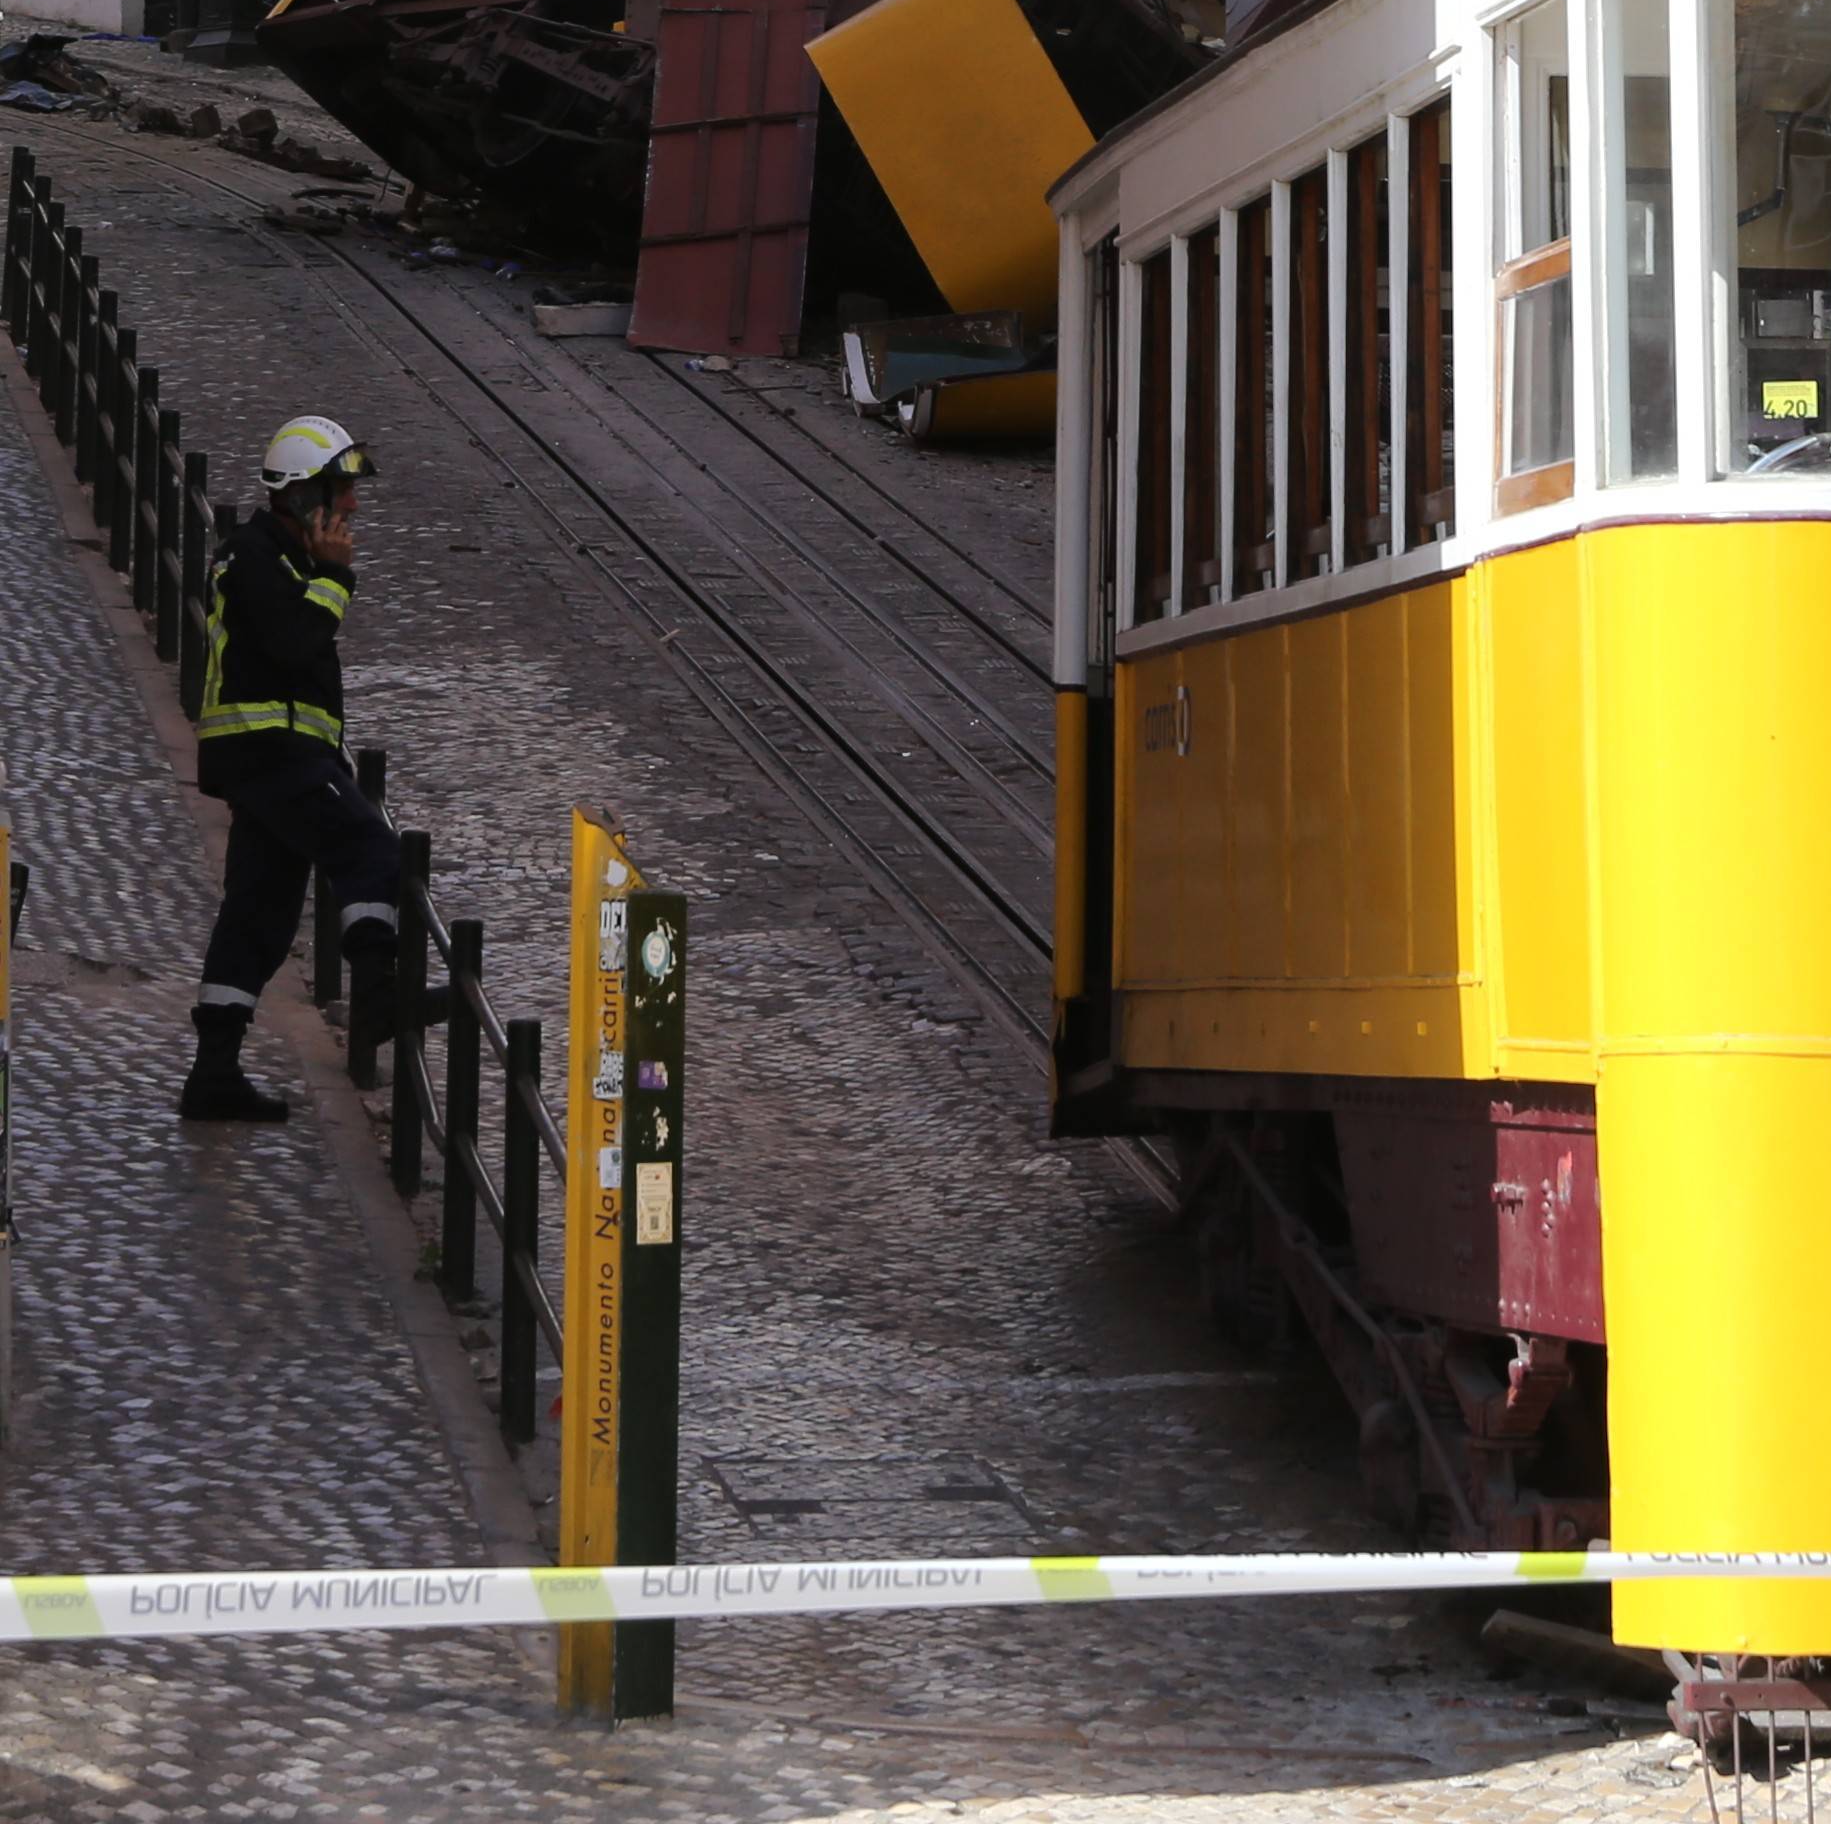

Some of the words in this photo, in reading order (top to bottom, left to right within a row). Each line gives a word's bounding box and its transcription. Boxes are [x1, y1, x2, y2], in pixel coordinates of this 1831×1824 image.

[599, 971, 617, 1045] carri
[595, 1094, 617, 1240] Nanal
[592, 1262, 614, 1445] Monumento
